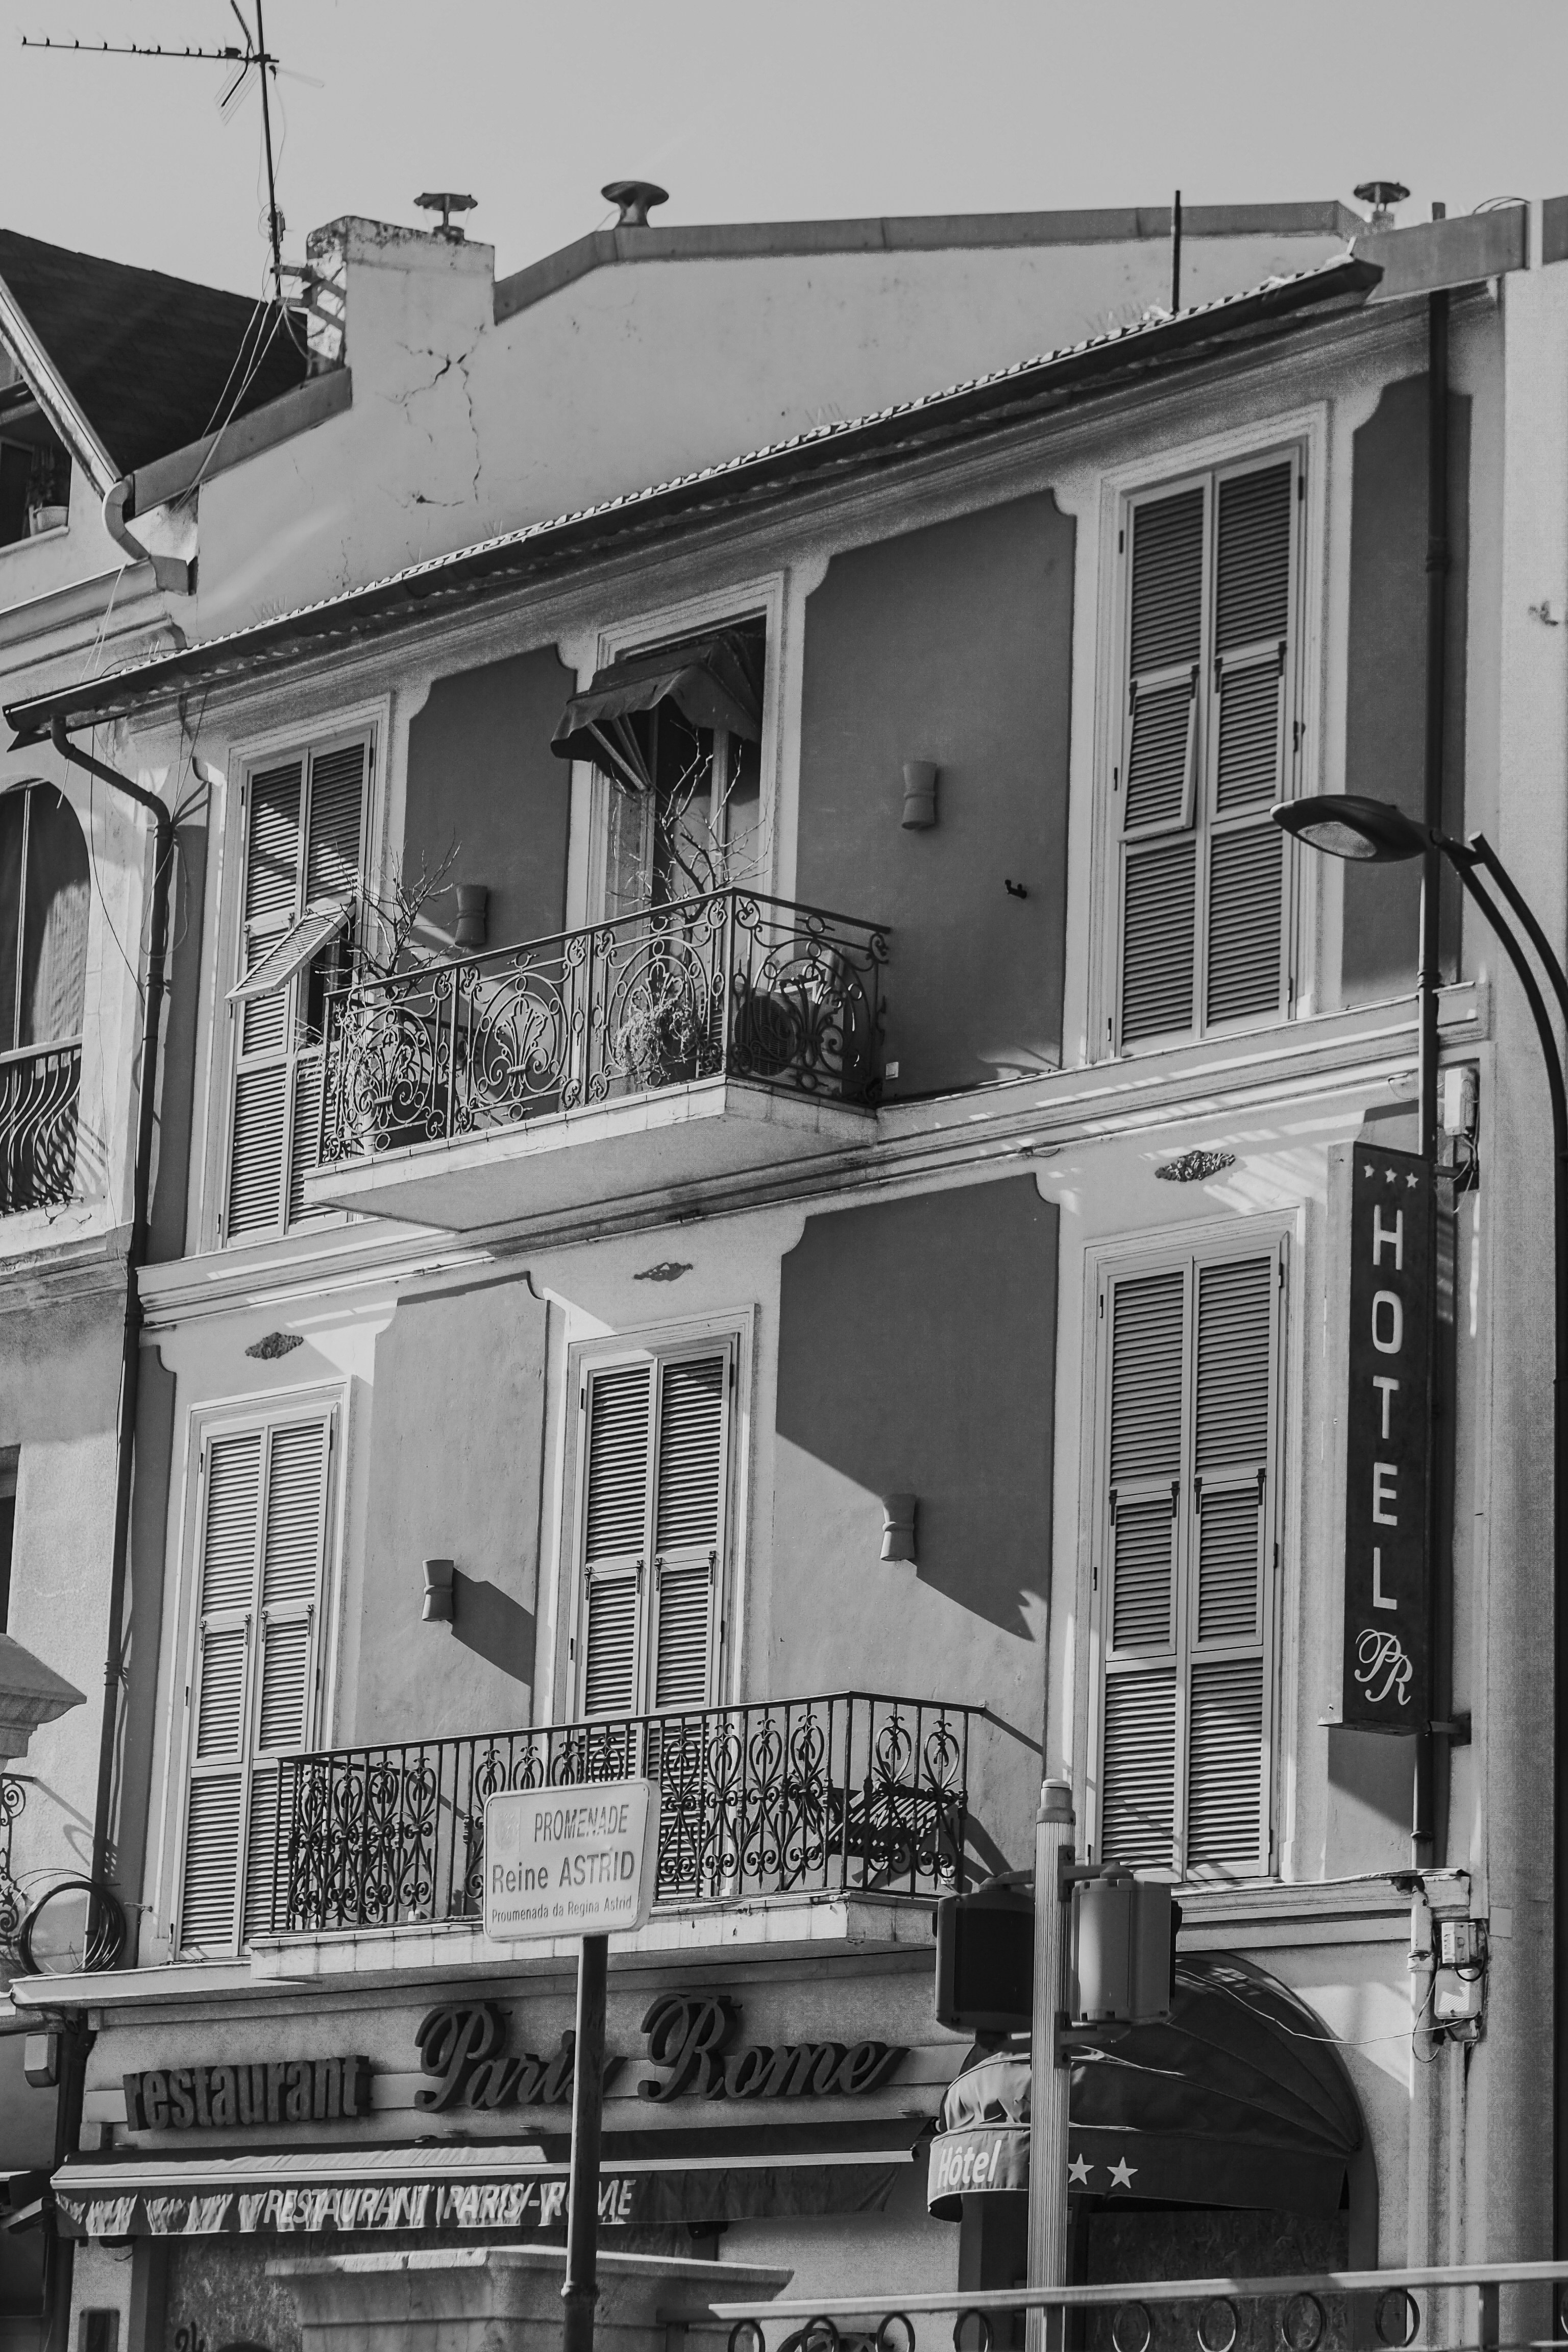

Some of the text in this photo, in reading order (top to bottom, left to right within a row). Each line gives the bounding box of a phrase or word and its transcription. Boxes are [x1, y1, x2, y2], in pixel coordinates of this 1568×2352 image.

[1371, 1204, 1403, 1610] HOTEL
[534, 1804, 629, 1843] PROMENADE
[493, 1850, 635, 1895] Reine ASTRID
[492, 1895, 632, 1924] Proumenada da Regina Astrid
[123, 1994, 913, 2132] restaurant Pari Rome
[937, 2139, 1002, 2189] Hôtel
[263, 2185, 435, 2223] RESTAURANT
